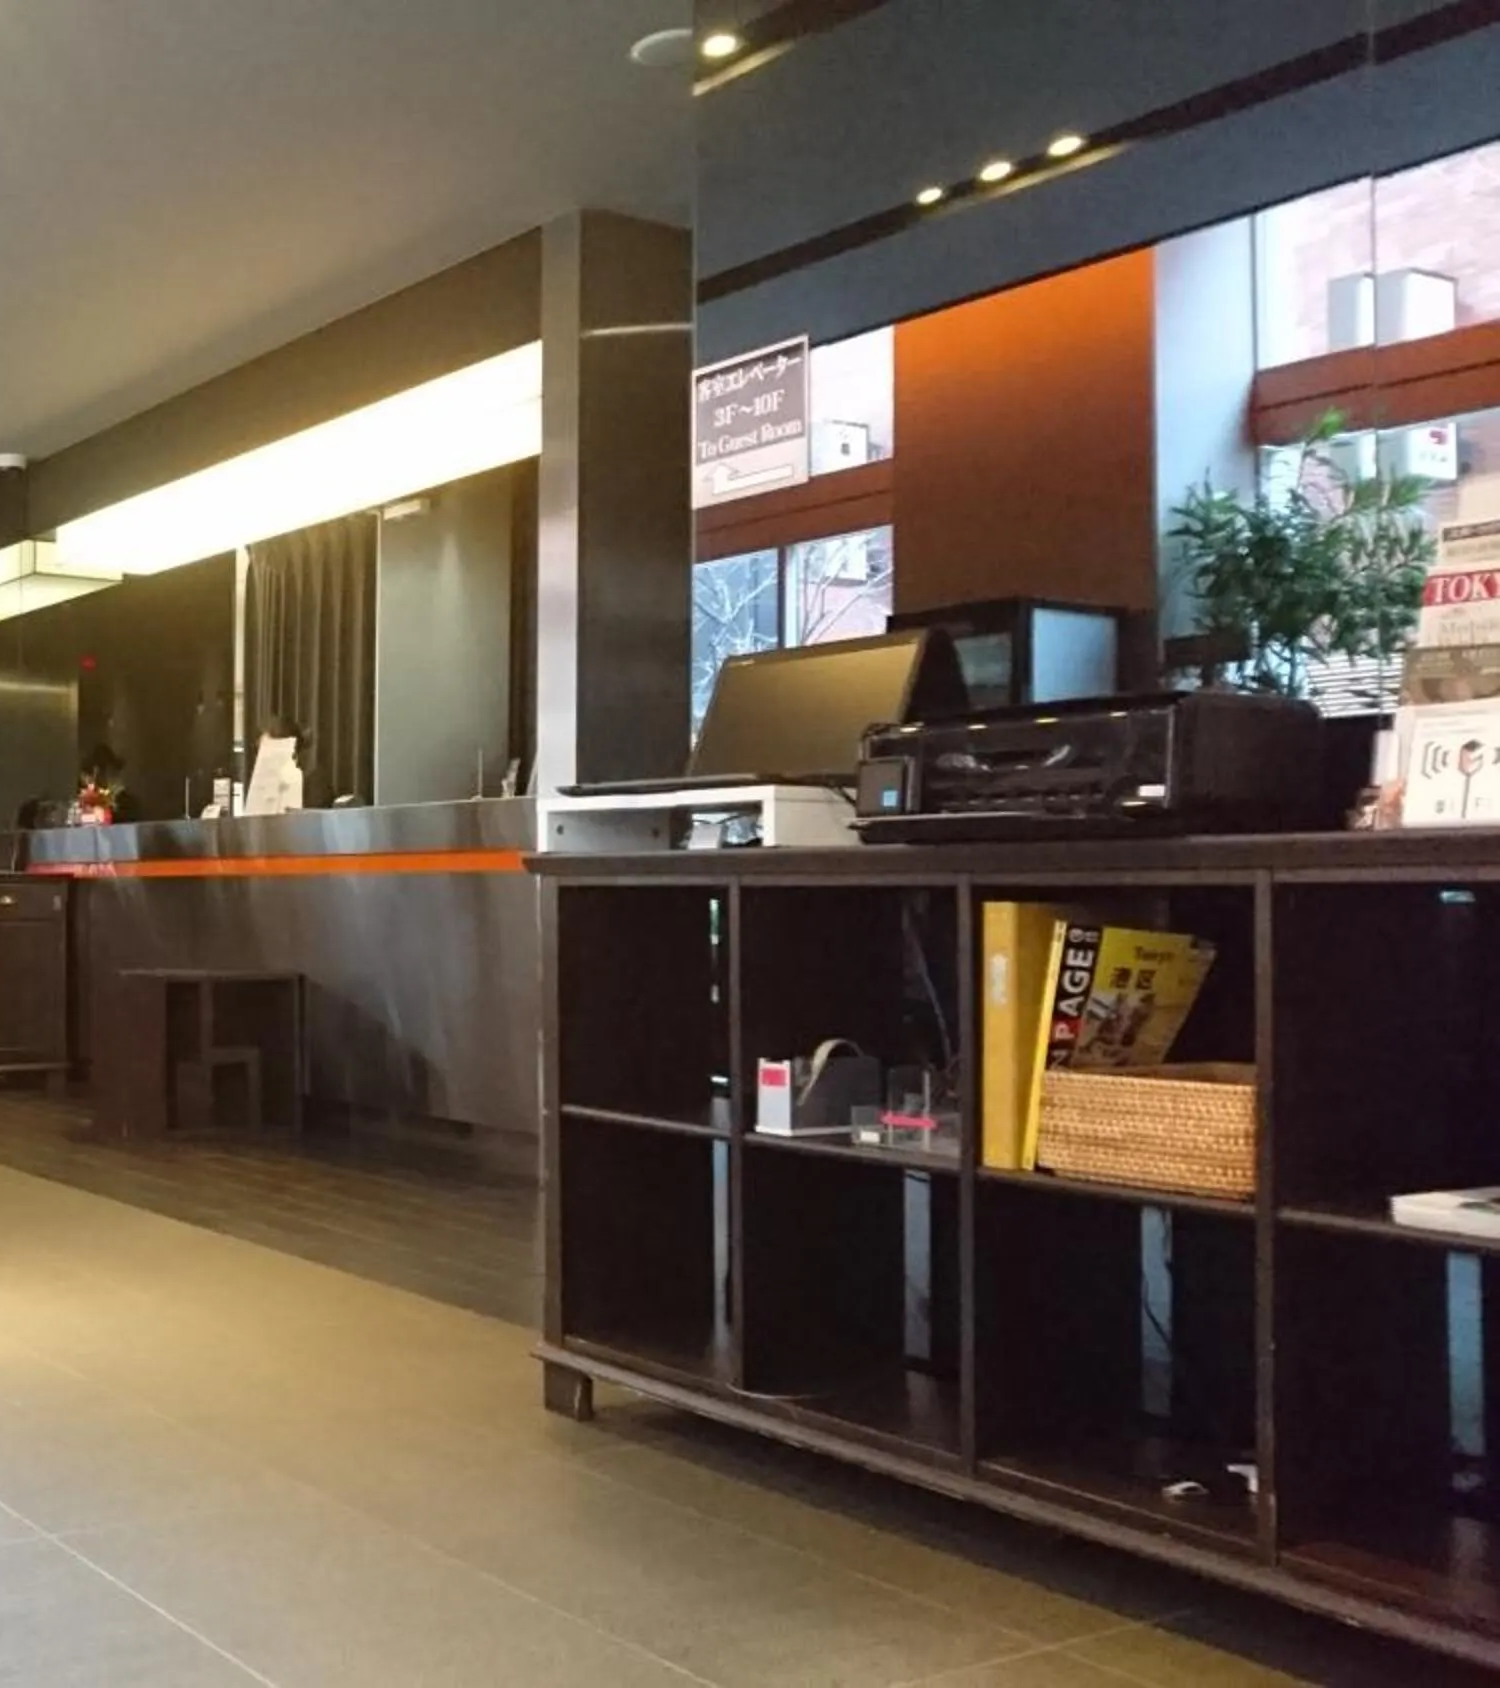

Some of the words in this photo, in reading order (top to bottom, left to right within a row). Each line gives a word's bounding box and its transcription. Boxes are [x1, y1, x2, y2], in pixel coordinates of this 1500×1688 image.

[698, 440, 718, 460] To
[718, 429, 758, 454] Guest
[760, 418, 803, 442] Room
